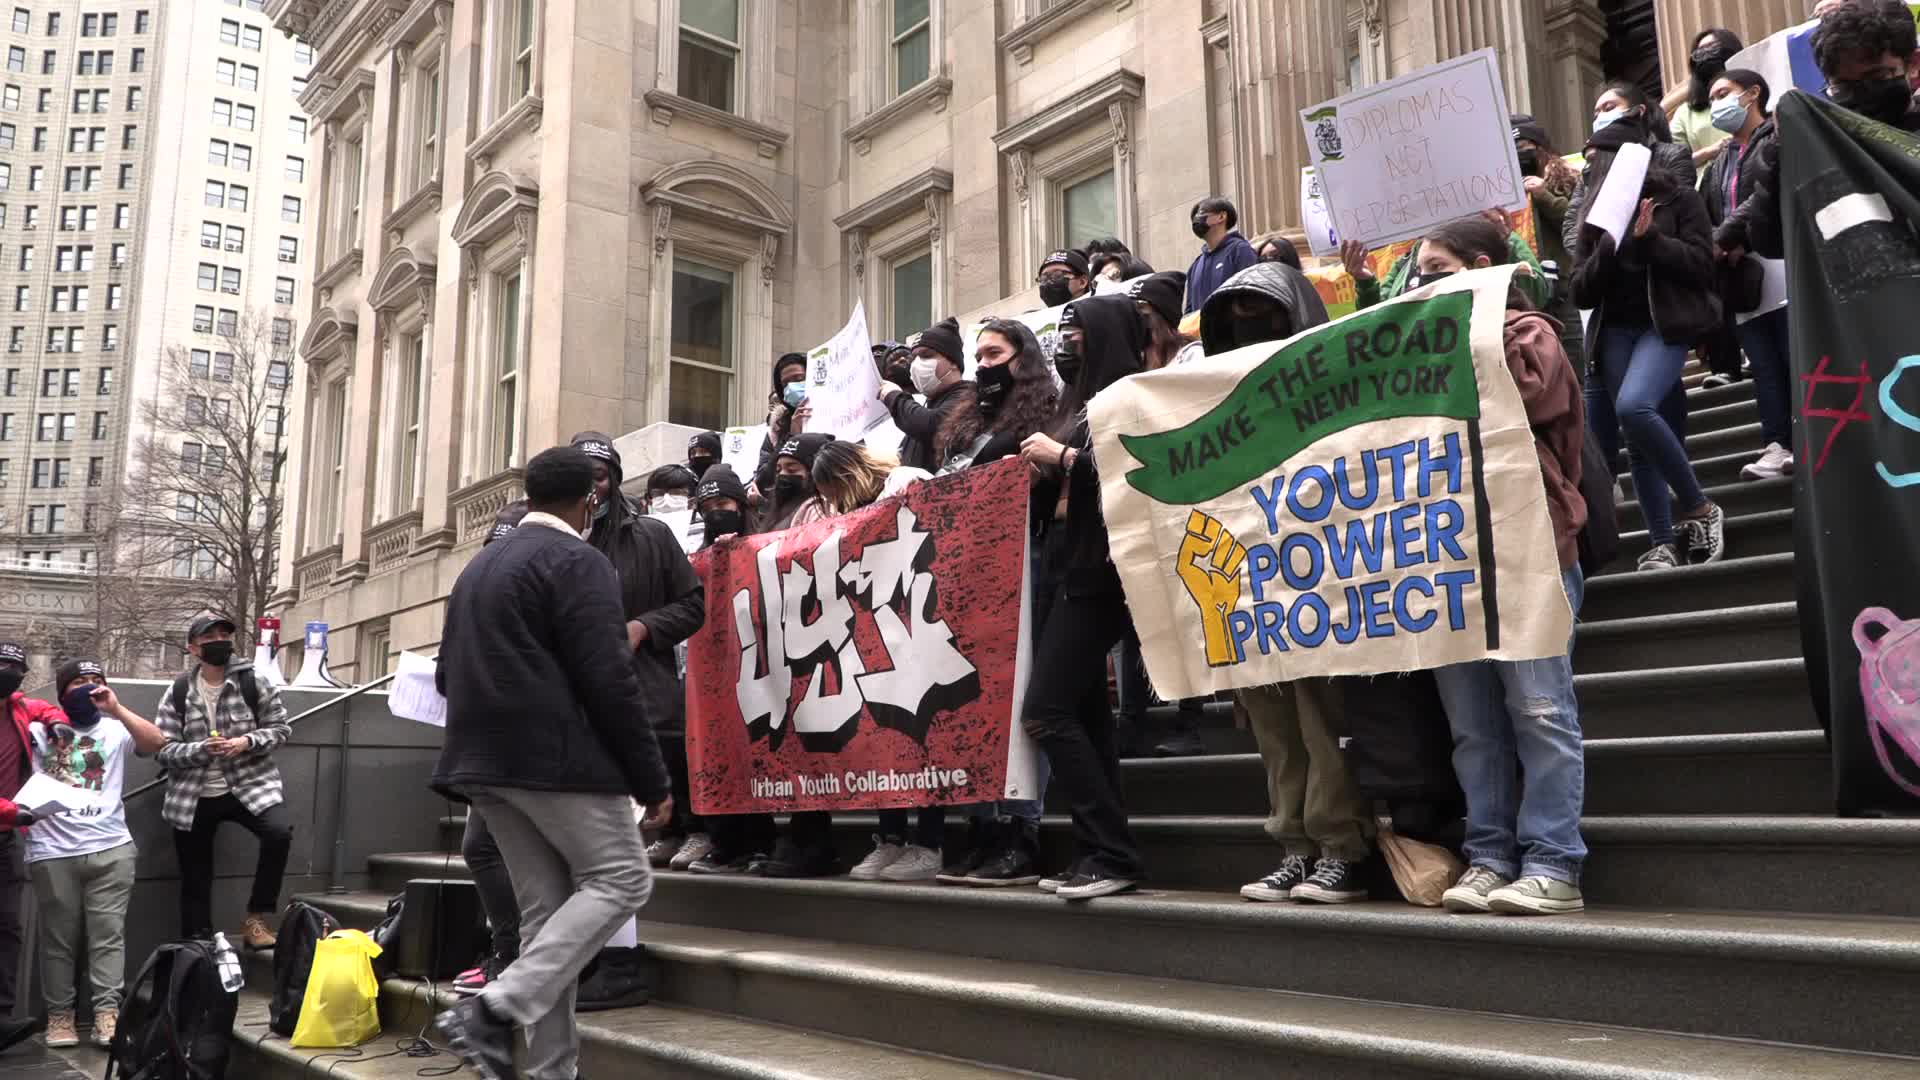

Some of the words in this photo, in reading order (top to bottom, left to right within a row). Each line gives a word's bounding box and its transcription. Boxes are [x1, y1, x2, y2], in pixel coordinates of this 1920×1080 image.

[1344, 80, 1474, 150] DIPLOMAS
[1385, 137, 1433, 178] NOT
[1167, 406, 1256, 478] MAKE
[1258, 345, 1329, 407] THE
[1345, 316, 1459, 369] ROAD
[1290, 377, 1361, 432] NEW
[1373, 363, 1452, 395] YORK
[1250, 432, 1462, 536] YOUTH
[1247, 499, 1468, 601] POWER
[1227, 569, 1475, 663] PROJECT
[750, 777, 793, 798] Urban
[799, 772, 841, 795] Youth
[845, 766, 969, 793] Collaborative
